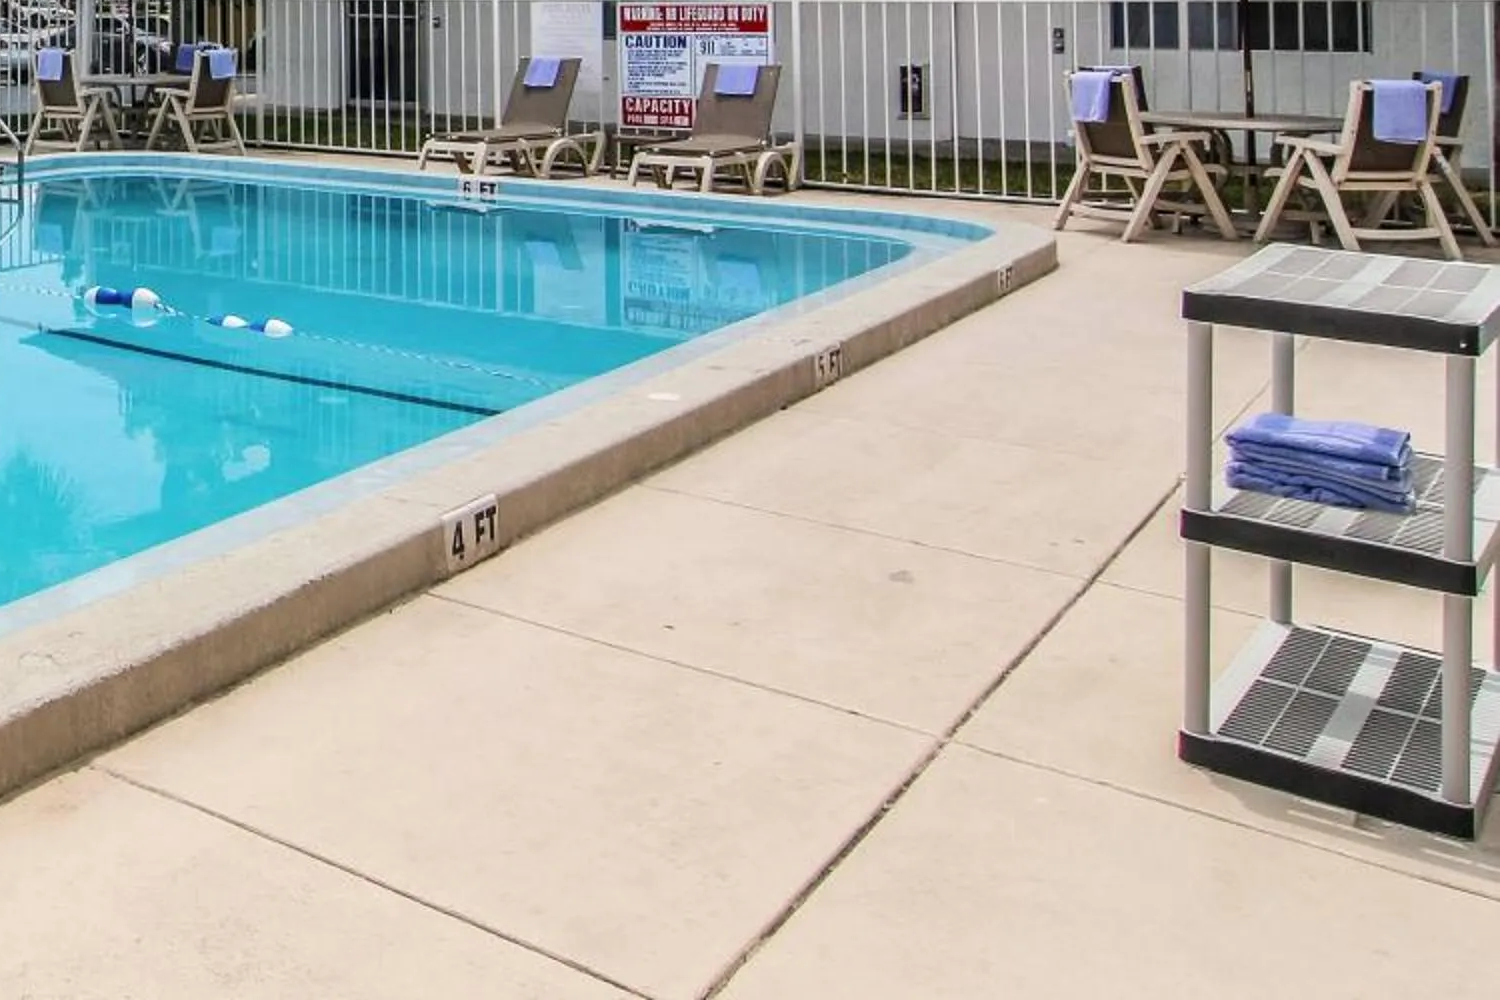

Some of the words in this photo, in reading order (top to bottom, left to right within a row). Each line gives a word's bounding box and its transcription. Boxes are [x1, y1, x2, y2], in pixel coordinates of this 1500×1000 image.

[742, 7, 765, 22] DUTY
[625, 35, 687, 49] CAUTION
[700, 40, 715, 55] 911
[626, 98, 690, 115] CAPACITY
[480, 182, 496, 195] FT
[829, 349, 841, 377] FT
[452, 519, 465, 560] 4
[474, 504, 497, 545] FT
